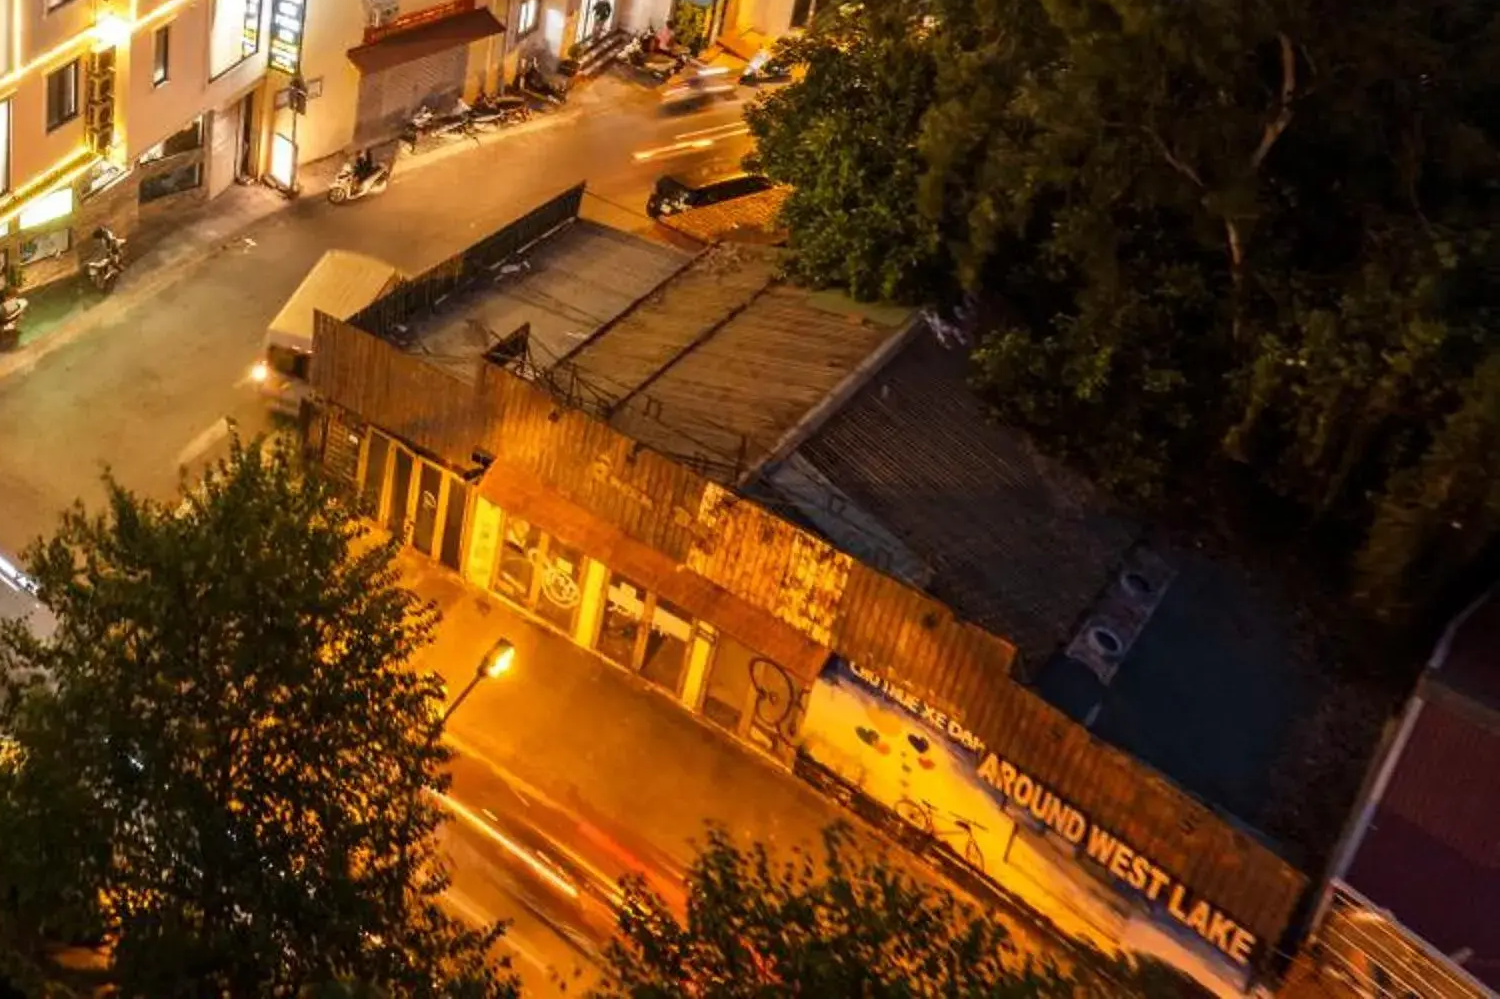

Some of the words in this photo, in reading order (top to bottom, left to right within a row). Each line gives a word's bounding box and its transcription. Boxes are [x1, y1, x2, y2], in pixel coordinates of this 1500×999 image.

[977, 753, 1086, 843] AROUND
[1087, 824, 1170, 900] WEST
[1168, 885, 1257, 967] LAKE
